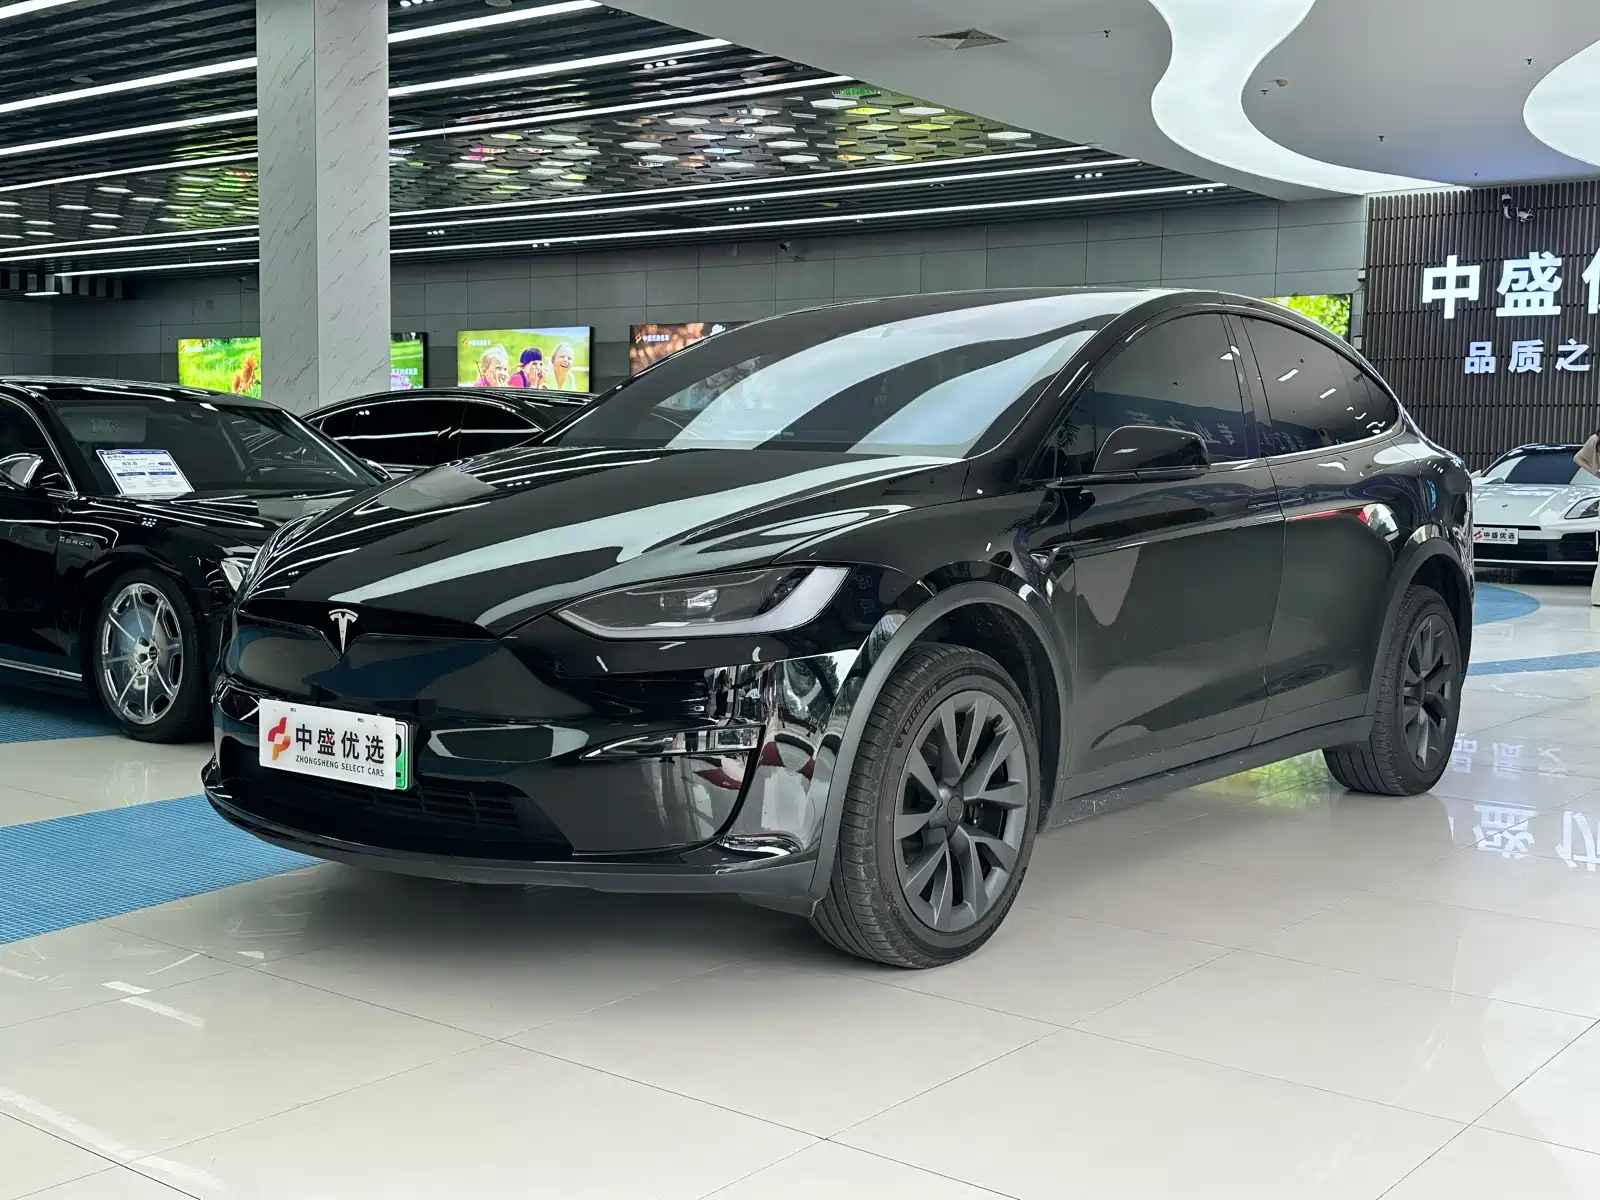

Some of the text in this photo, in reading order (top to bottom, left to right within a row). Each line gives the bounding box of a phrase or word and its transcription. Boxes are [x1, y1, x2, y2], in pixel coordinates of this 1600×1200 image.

[1422, 248, 1600, 319] 中盛
[1464, 338, 1591, 374] 品质之
[295, 723, 385, 765] 中盛优选
[295, 754, 385, 777] ZHONGSHENG SELECT CARS
